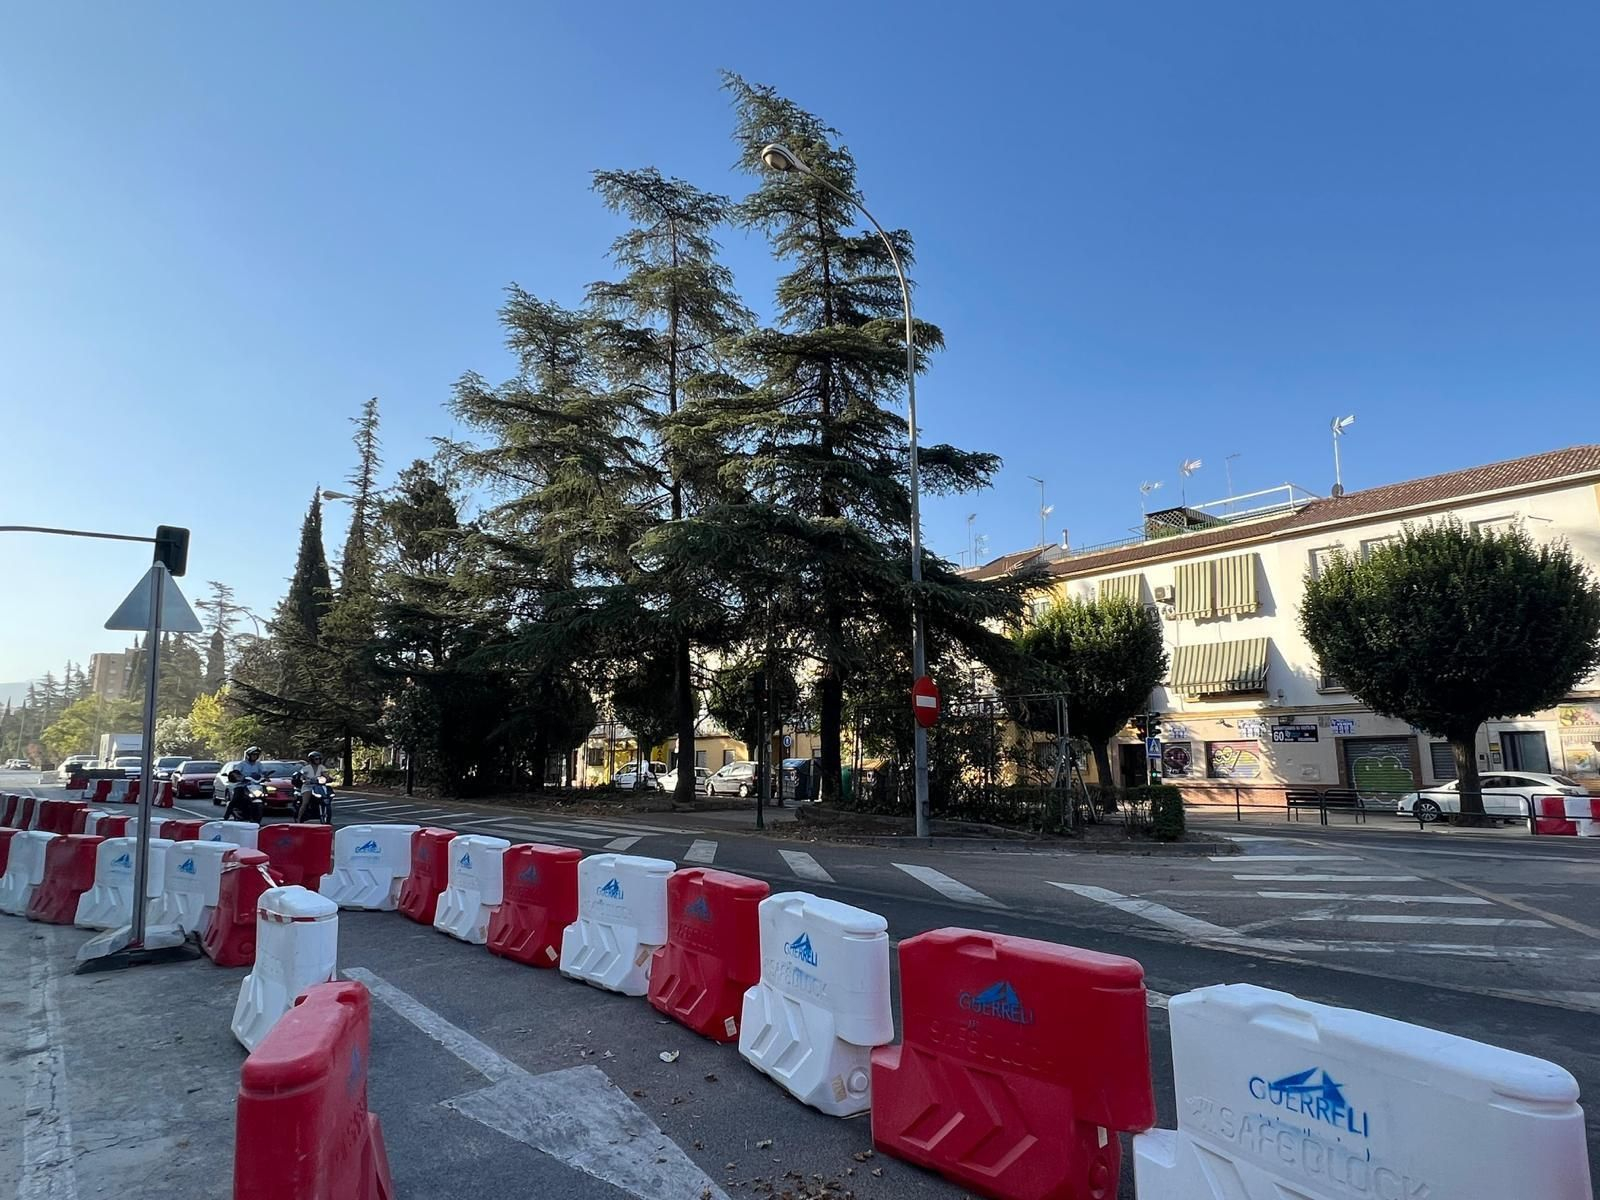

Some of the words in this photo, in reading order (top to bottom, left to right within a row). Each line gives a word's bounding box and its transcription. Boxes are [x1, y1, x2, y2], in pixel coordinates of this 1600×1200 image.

[1273, 731, 1284, 741] 60
[959, 991, 1034, 1024] GUERRELI
[1249, 1076, 1368, 1138] GUERRELI
